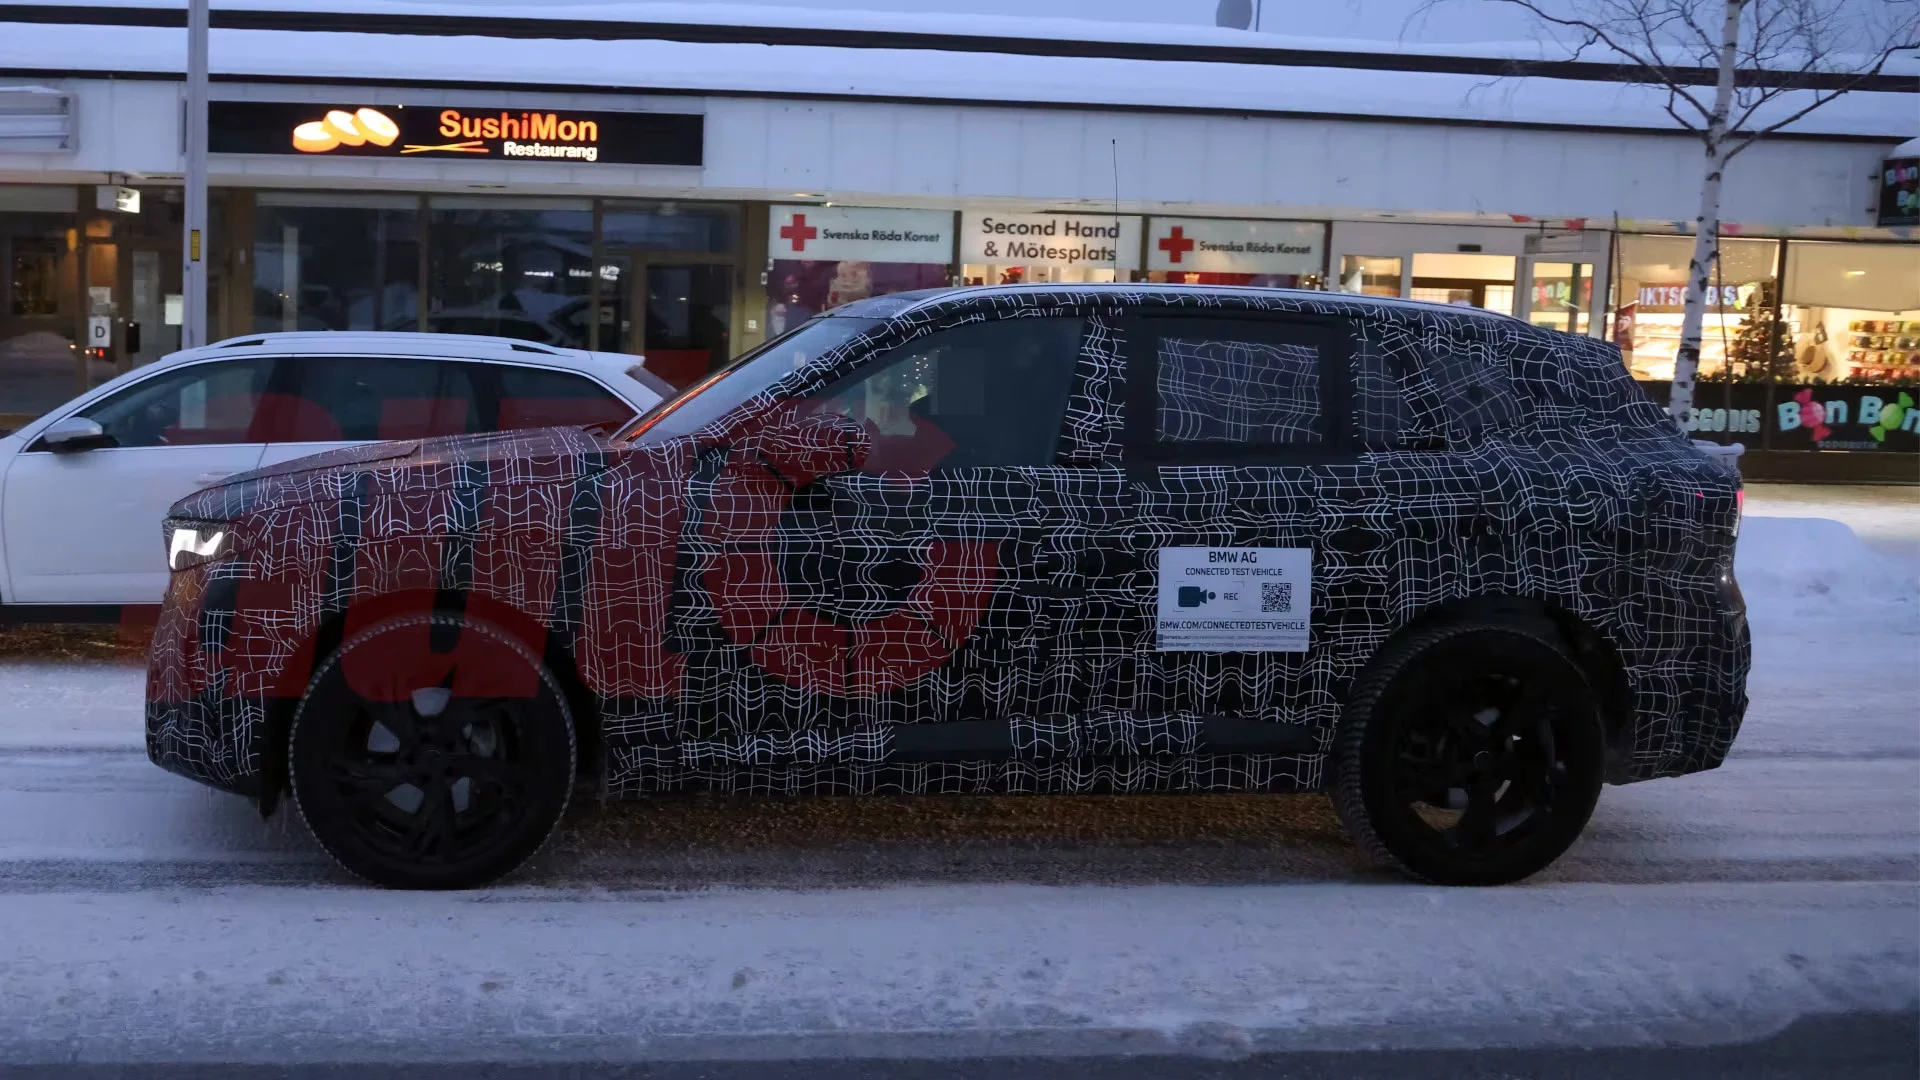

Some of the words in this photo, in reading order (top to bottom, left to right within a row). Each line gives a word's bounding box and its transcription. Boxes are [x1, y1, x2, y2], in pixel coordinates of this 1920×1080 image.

[439, 110, 598, 142] SushiMon
[503, 141, 598, 161] Restaurang
[982, 217, 1056, 236] Second
[1065, 221, 1120, 238] Hand
[823, 229, 870, 241] Svenska
[872, 230, 902, 241] Röda
[904, 231, 940, 242] Korset
[983, 241, 998, 257] &
[1006, 241, 1116, 264] Mötesplats
[1200, 240, 1244, 252] Svenska
[1246, 242, 1275, 253] Röda
[1277, 243, 1311, 254] Korset
[95, 325, 106, 338] D
[1209, 551, 1238, 563] BMW
[1241, 552, 1257, 563] AG
[1185, 567, 1230, 576] CONNECTED
[1231, 568, 1249, 576] TEST
[1251, 568, 1283, 576] VEHICLE
[1223, 593, 1239, 601] REC
[1159, 621, 1306, 630] BMW.COM/CONNECTEDTESTVEHICLE
